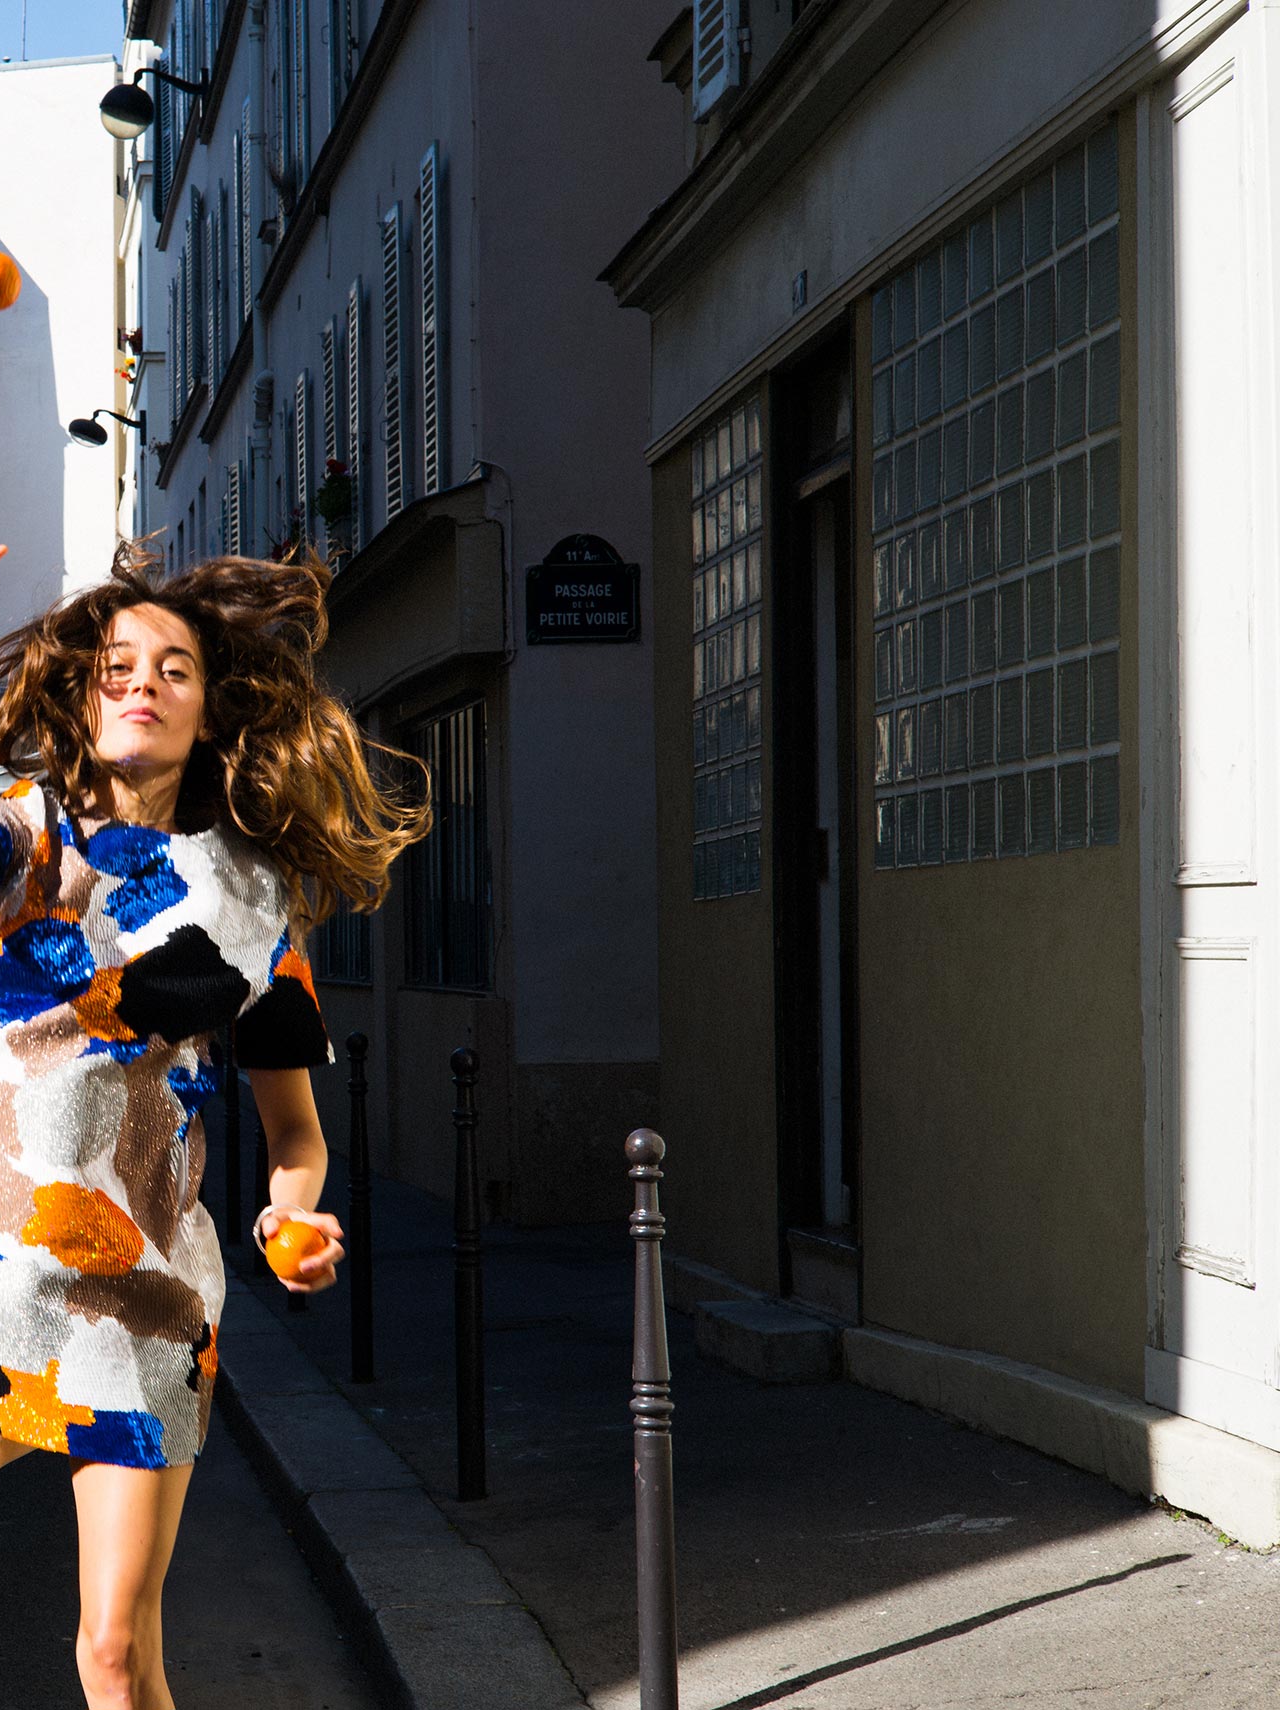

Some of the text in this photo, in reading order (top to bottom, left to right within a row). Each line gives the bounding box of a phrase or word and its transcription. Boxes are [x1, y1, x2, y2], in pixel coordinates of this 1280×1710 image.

[554, 583, 613, 598] PASSAGE
[571, 600, 595, 609] DE LA
[539, 611, 629, 626] PETITE VOIRIE
